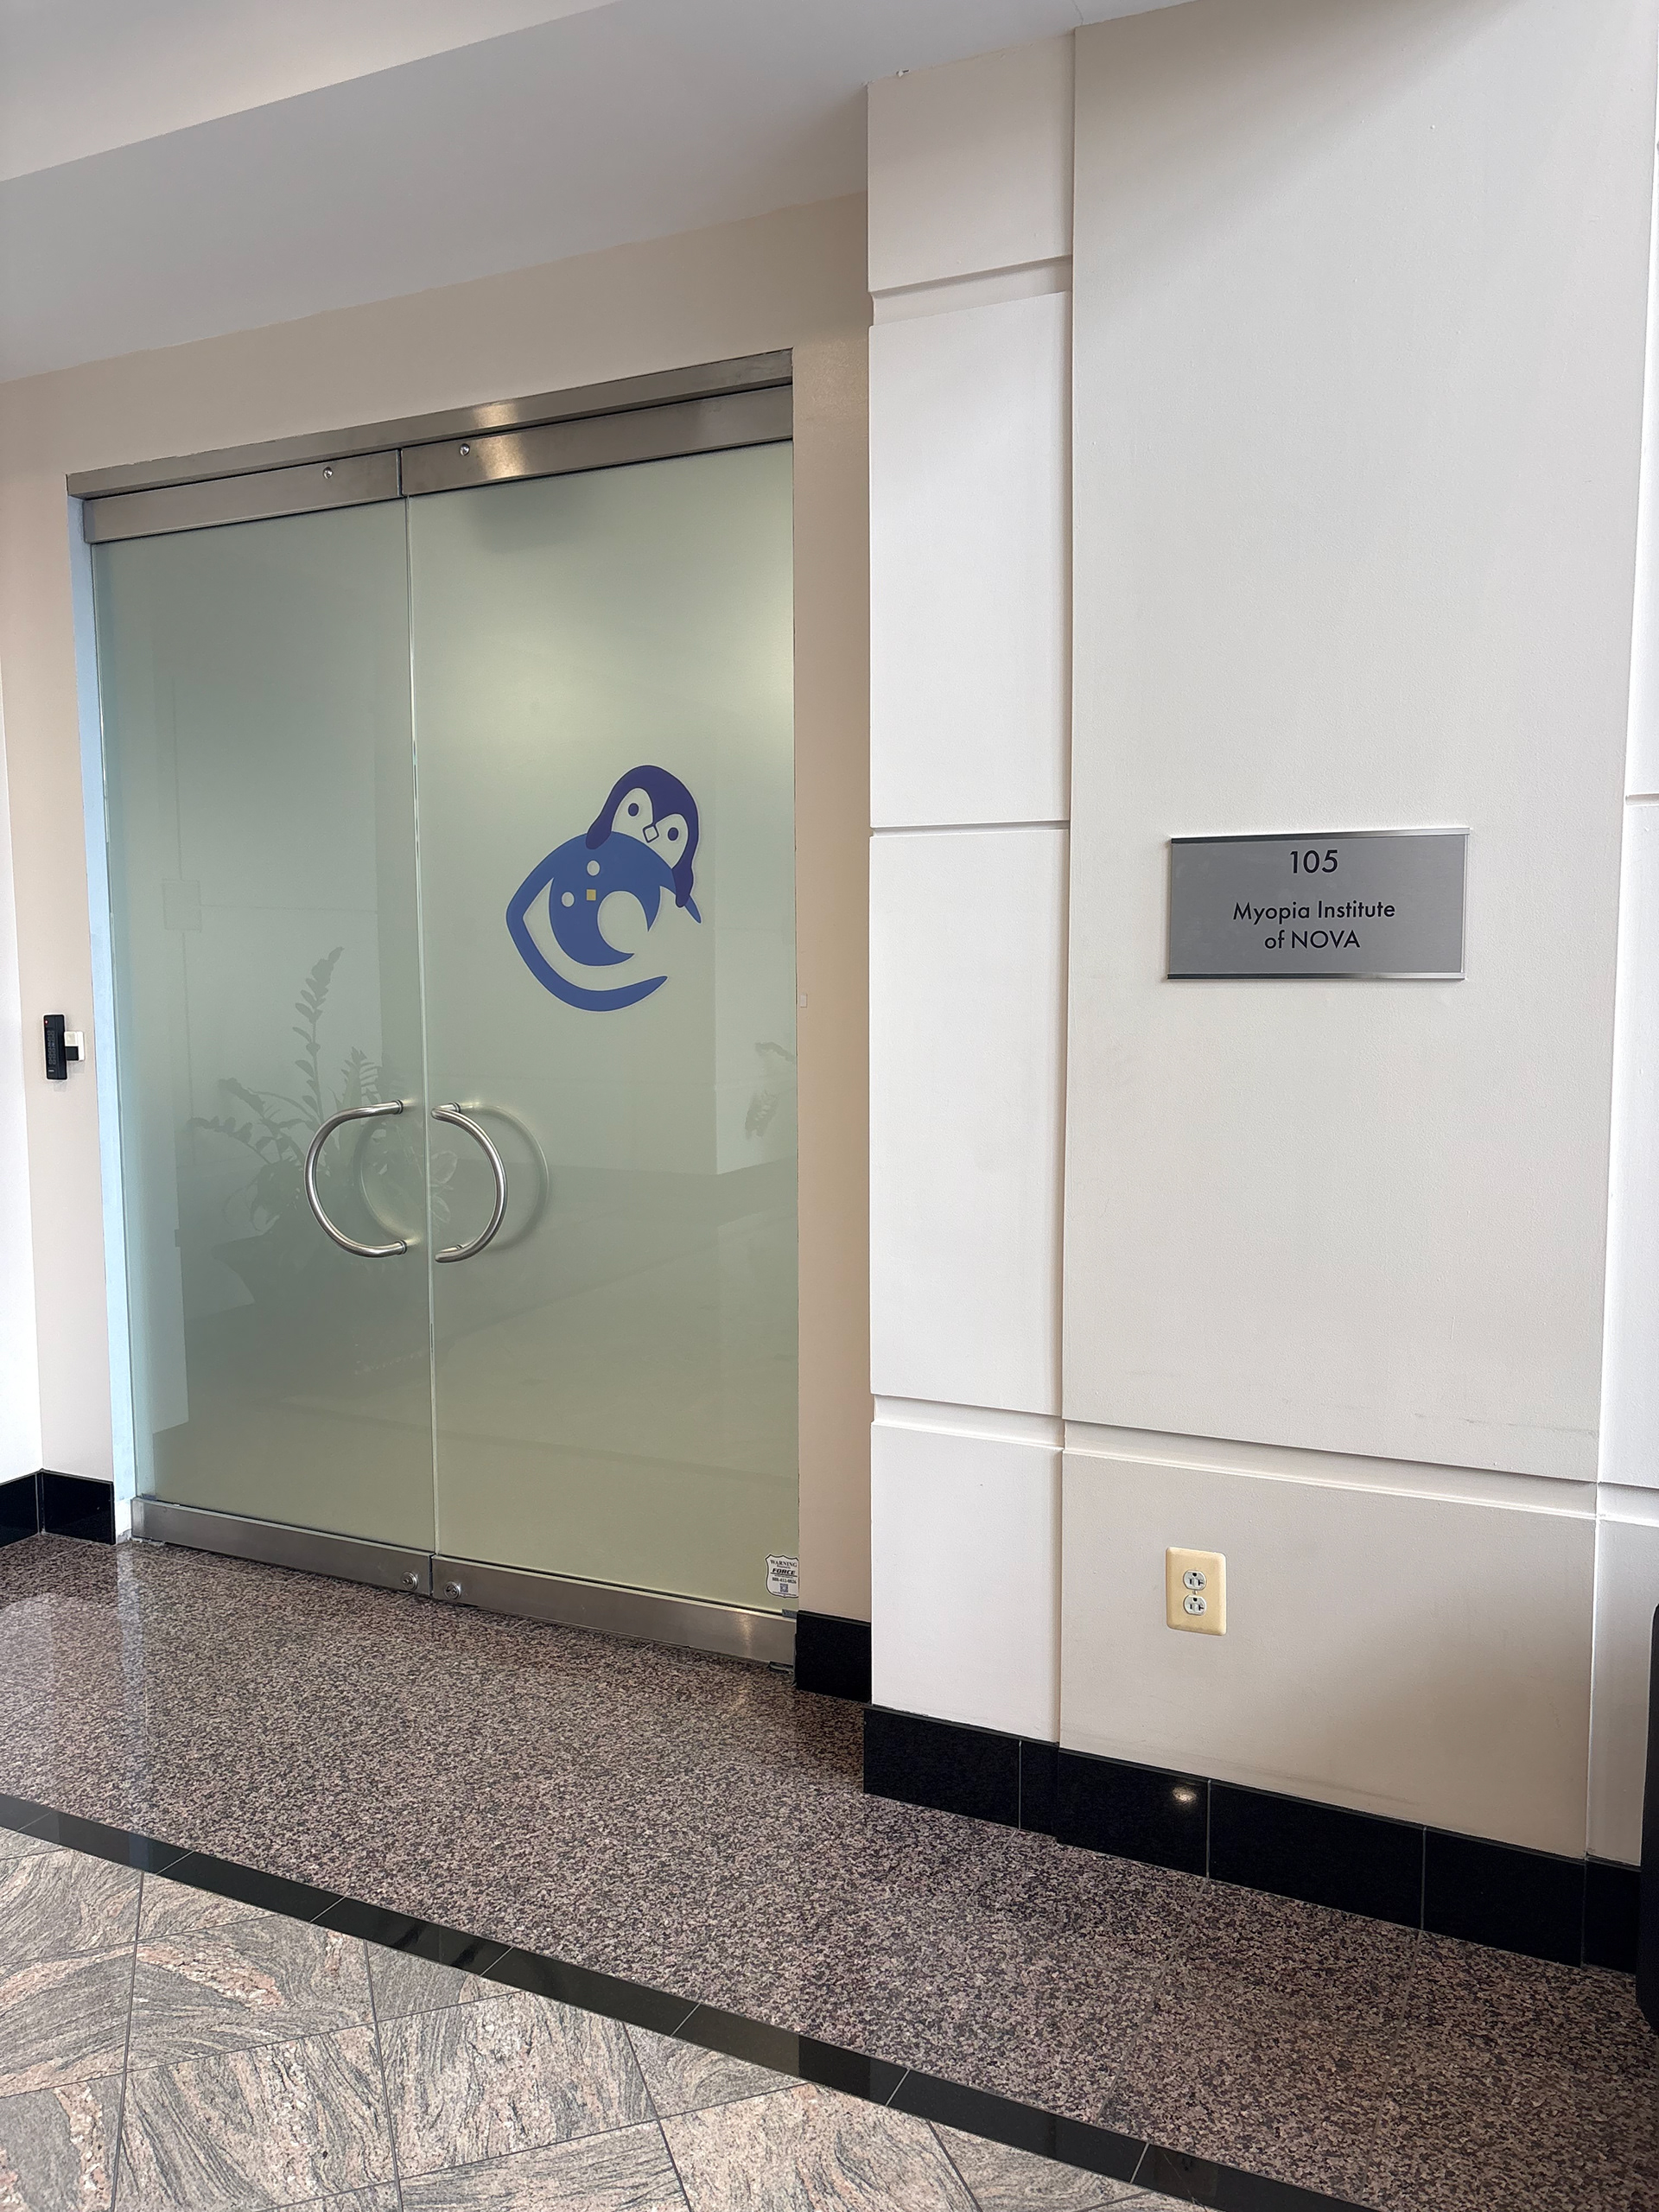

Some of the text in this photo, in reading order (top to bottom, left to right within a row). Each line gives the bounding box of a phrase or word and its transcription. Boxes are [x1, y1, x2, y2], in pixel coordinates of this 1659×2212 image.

[1289, 849, 1338, 874] 105
[1232, 899, 1395, 925] Myopia Institute
[1264, 930, 1361, 950] of NOVA
